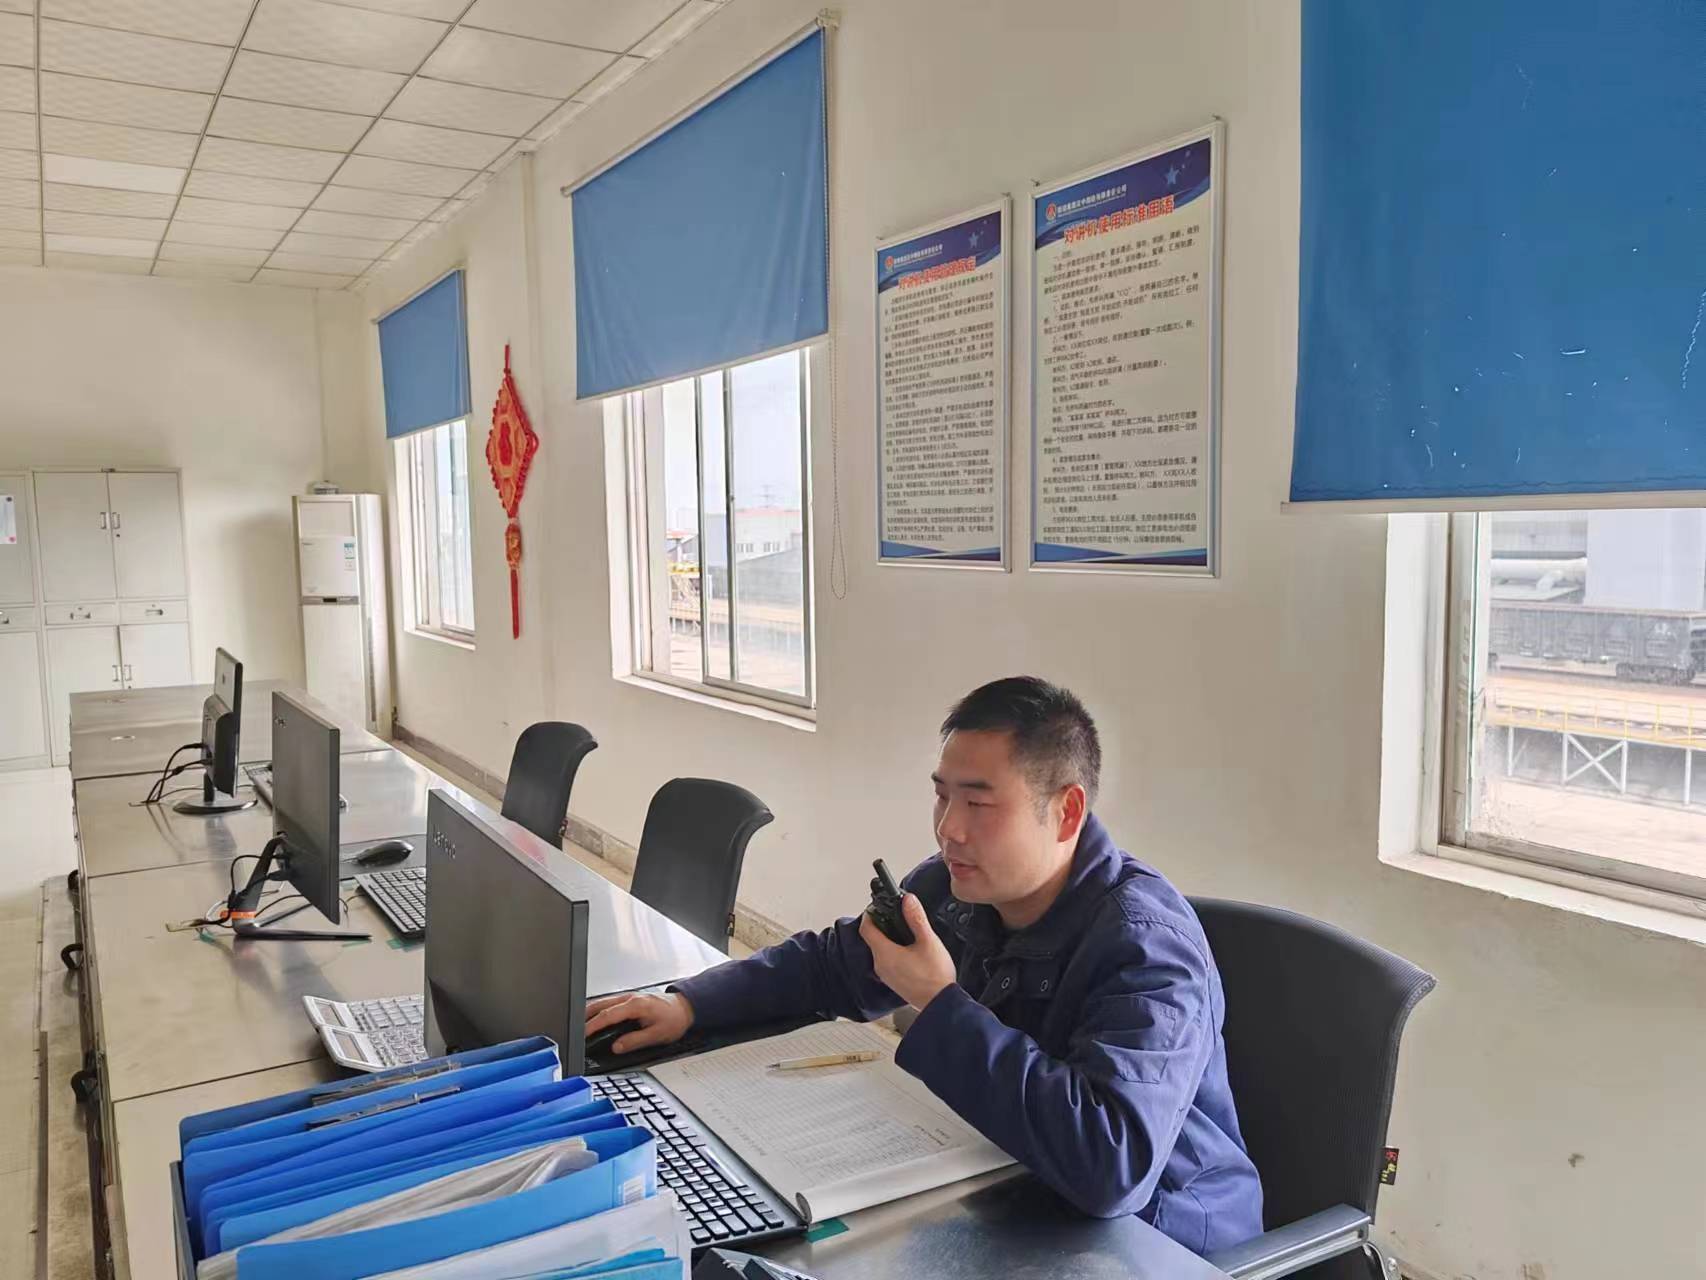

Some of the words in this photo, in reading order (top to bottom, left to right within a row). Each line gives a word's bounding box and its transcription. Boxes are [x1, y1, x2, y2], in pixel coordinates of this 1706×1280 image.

[1064, 194, 1175, 244] 对讲机使用标准用语
